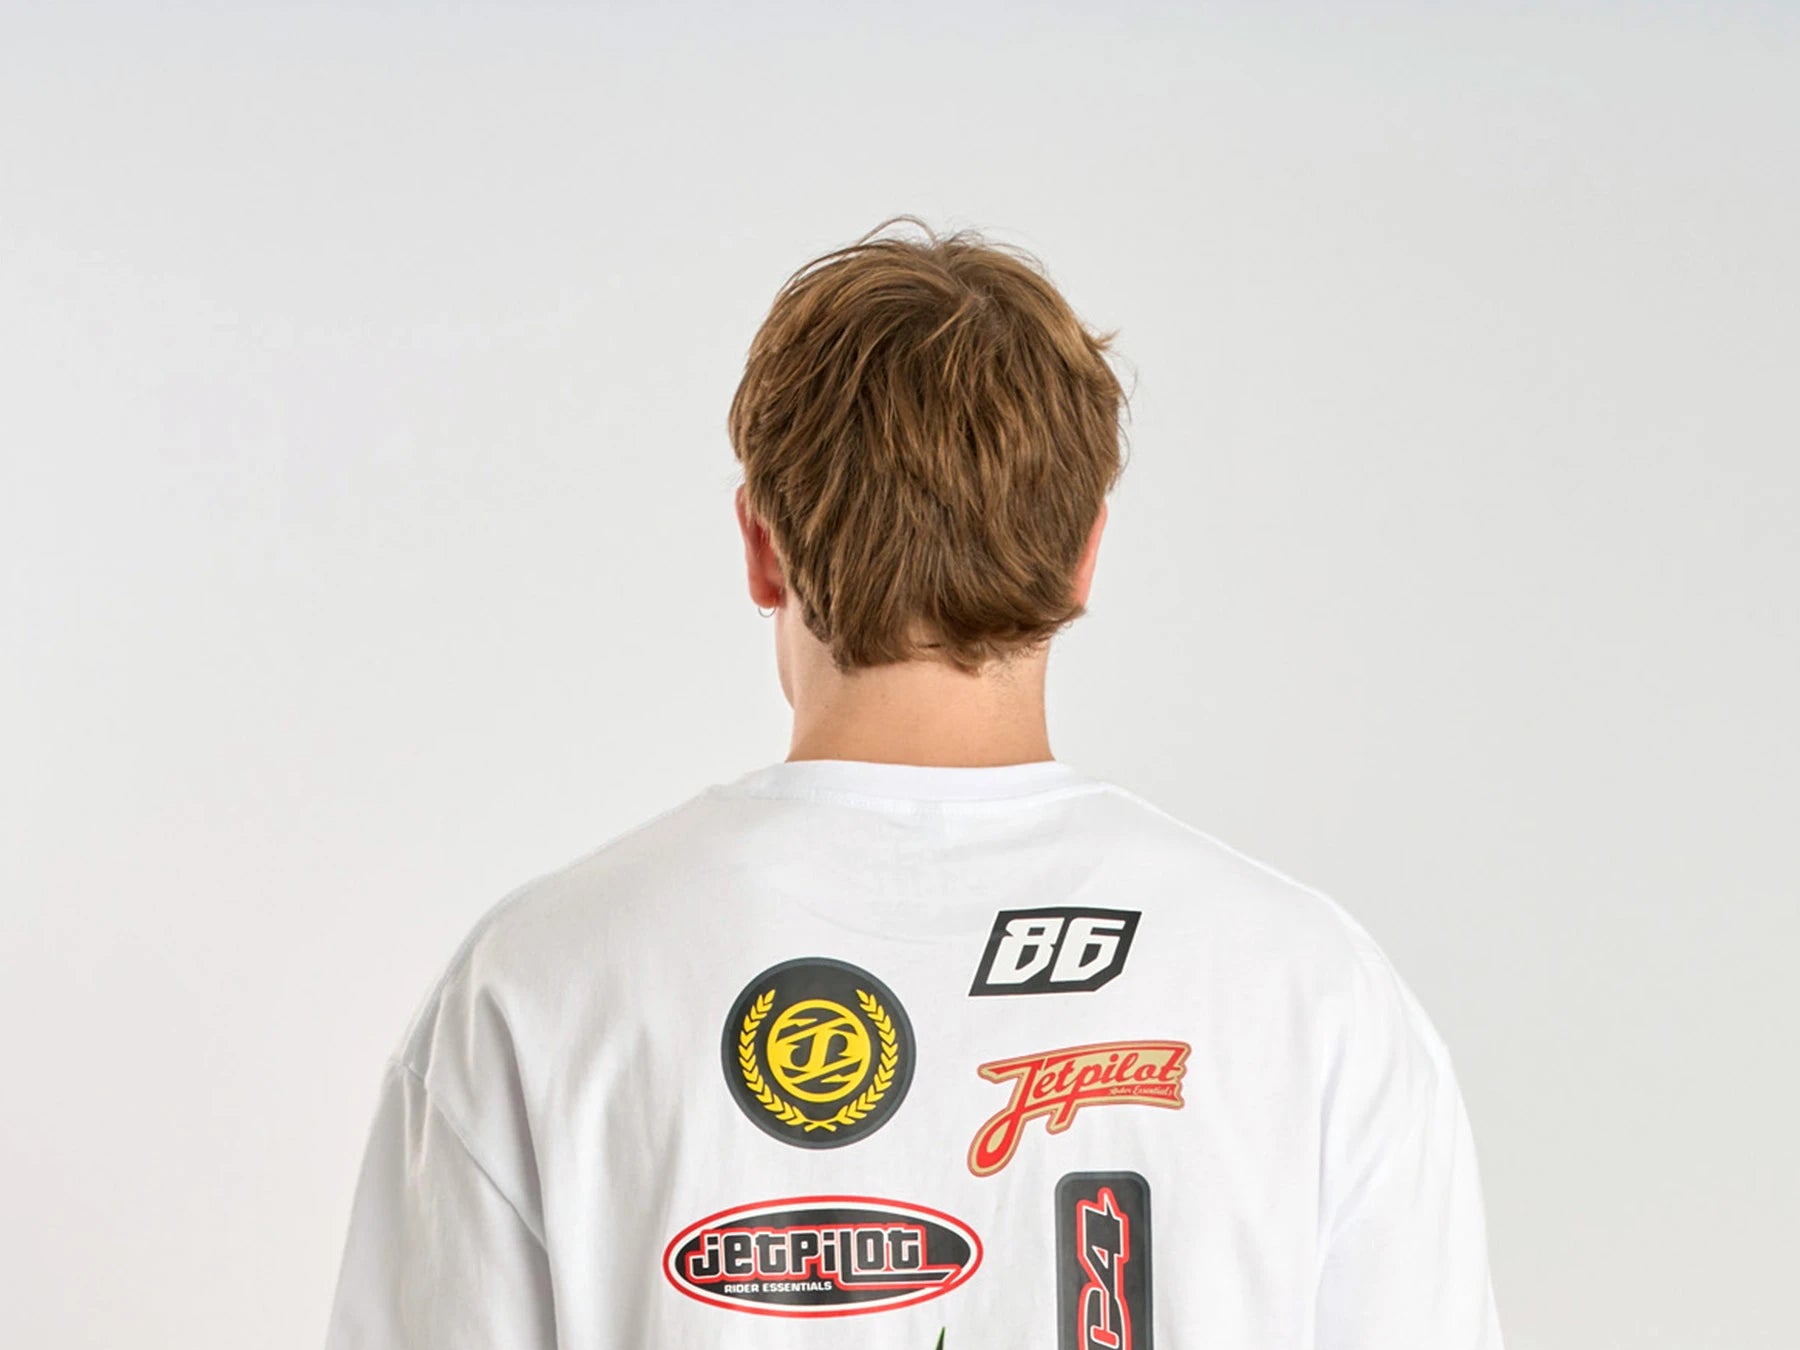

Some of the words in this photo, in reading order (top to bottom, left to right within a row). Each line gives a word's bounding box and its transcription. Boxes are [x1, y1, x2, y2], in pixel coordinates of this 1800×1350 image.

[985, 916, 1127, 985] 86
[975, 1045, 1187, 1169] Jetpilot
[724, 1283, 760, 1294] RIDER
[762, 1280, 832, 1293] ESSENTIALS
